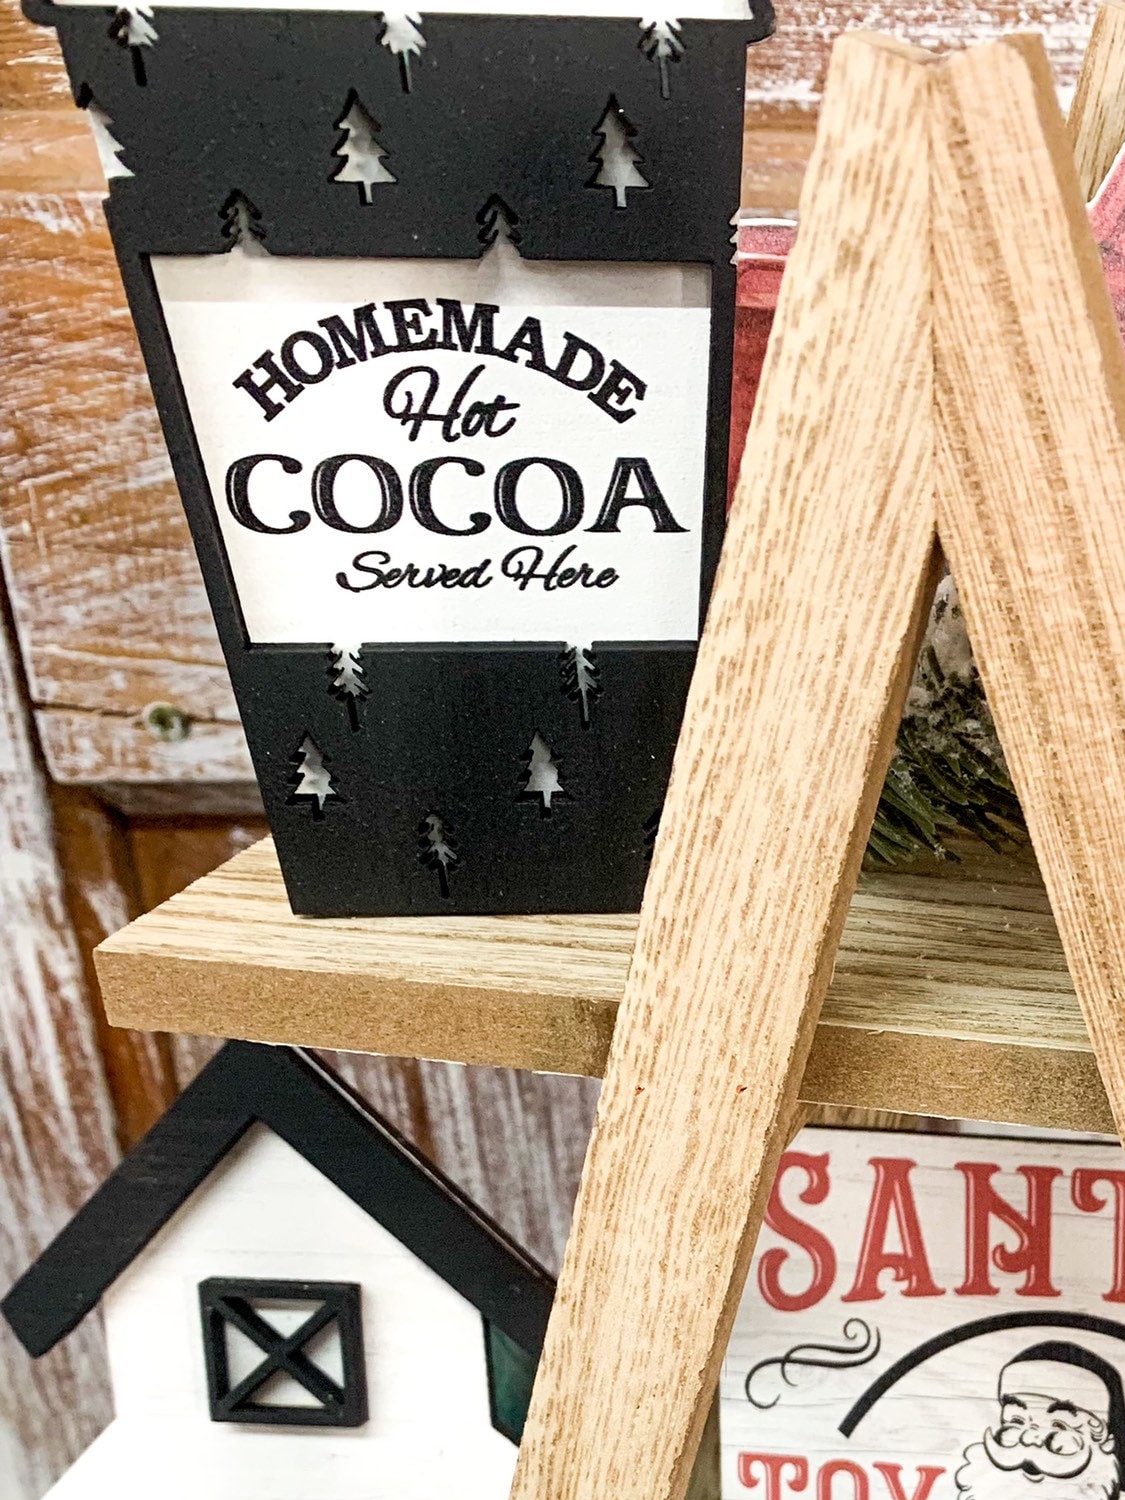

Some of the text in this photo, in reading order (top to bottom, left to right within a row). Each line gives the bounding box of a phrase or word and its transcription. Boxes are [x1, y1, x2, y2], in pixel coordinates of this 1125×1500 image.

[232, 297, 648, 423] HOMEMADE
[382, 363, 521, 443] Hot
[224, 452, 691, 537] COCOA
[335, 544, 620, 594] Served Here
